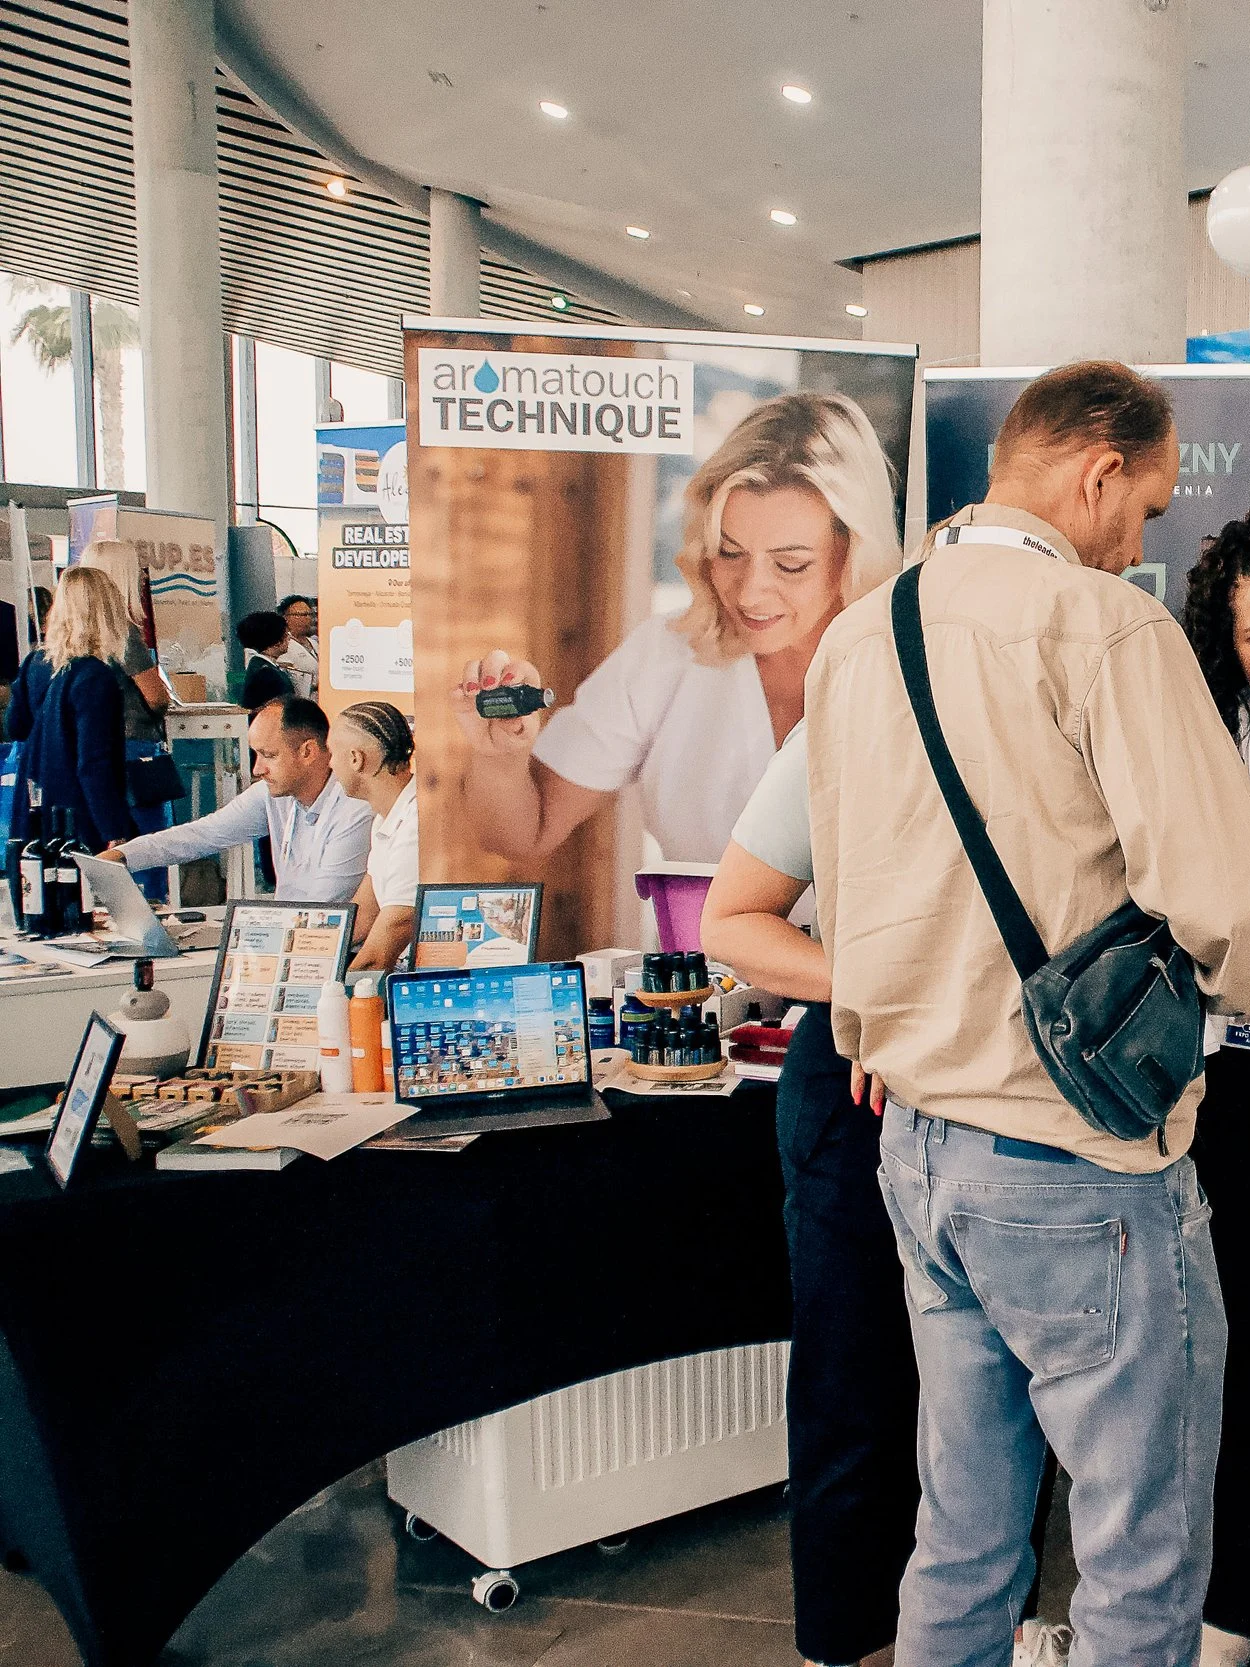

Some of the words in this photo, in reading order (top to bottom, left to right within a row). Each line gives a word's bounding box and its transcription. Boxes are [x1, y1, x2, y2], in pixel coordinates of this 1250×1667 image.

[432, 396, 682, 443] TECHNIQUE
[1173, 485, 1213, 495] ENIA
[344, 526, 384, 544] REAL
